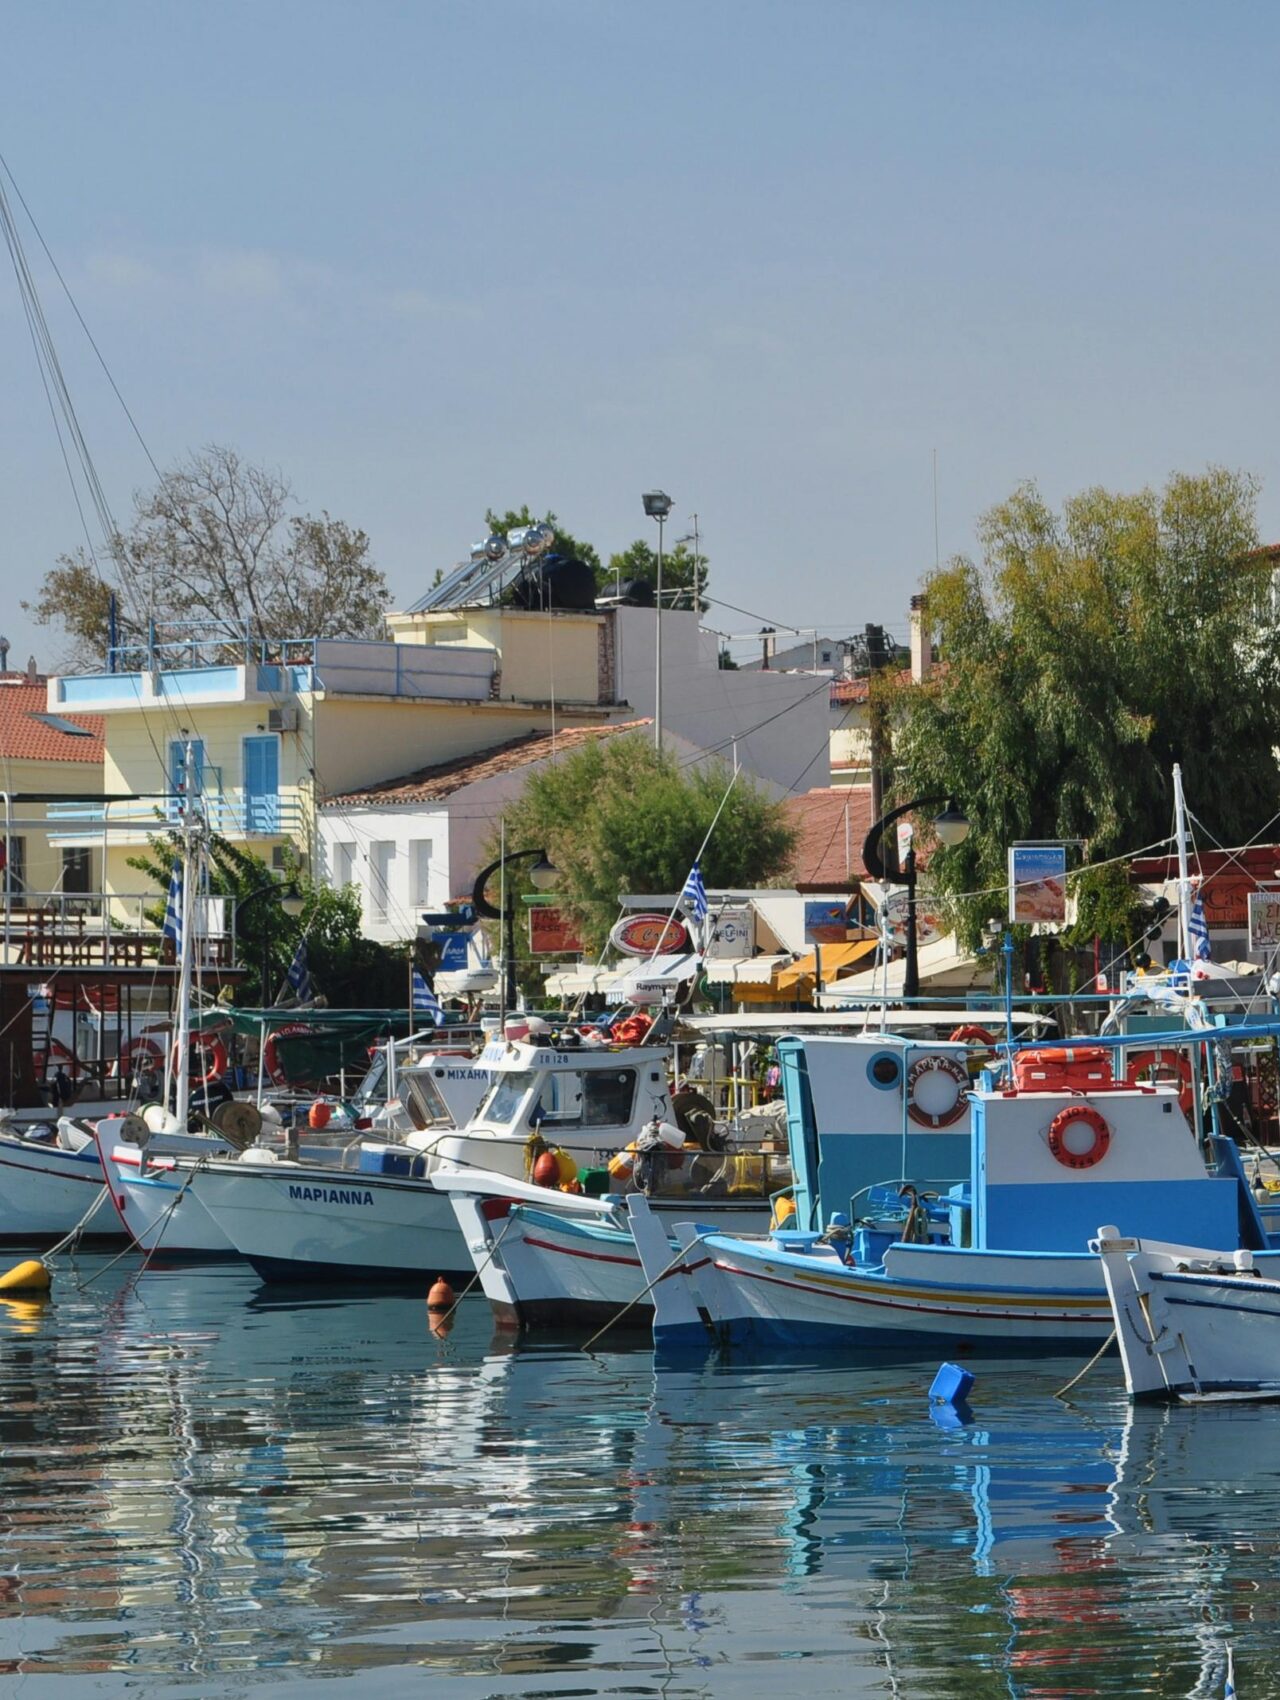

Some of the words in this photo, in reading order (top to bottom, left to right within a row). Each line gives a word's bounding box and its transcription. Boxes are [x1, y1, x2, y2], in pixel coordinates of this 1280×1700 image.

[1209, 888, 1248, 910] Cas
[447, 1069, 488, 1080] ΜΙΧΑΗΛ
[289, 1185, 374, 1206] ΜΑΡΙΑΝΝΑ
